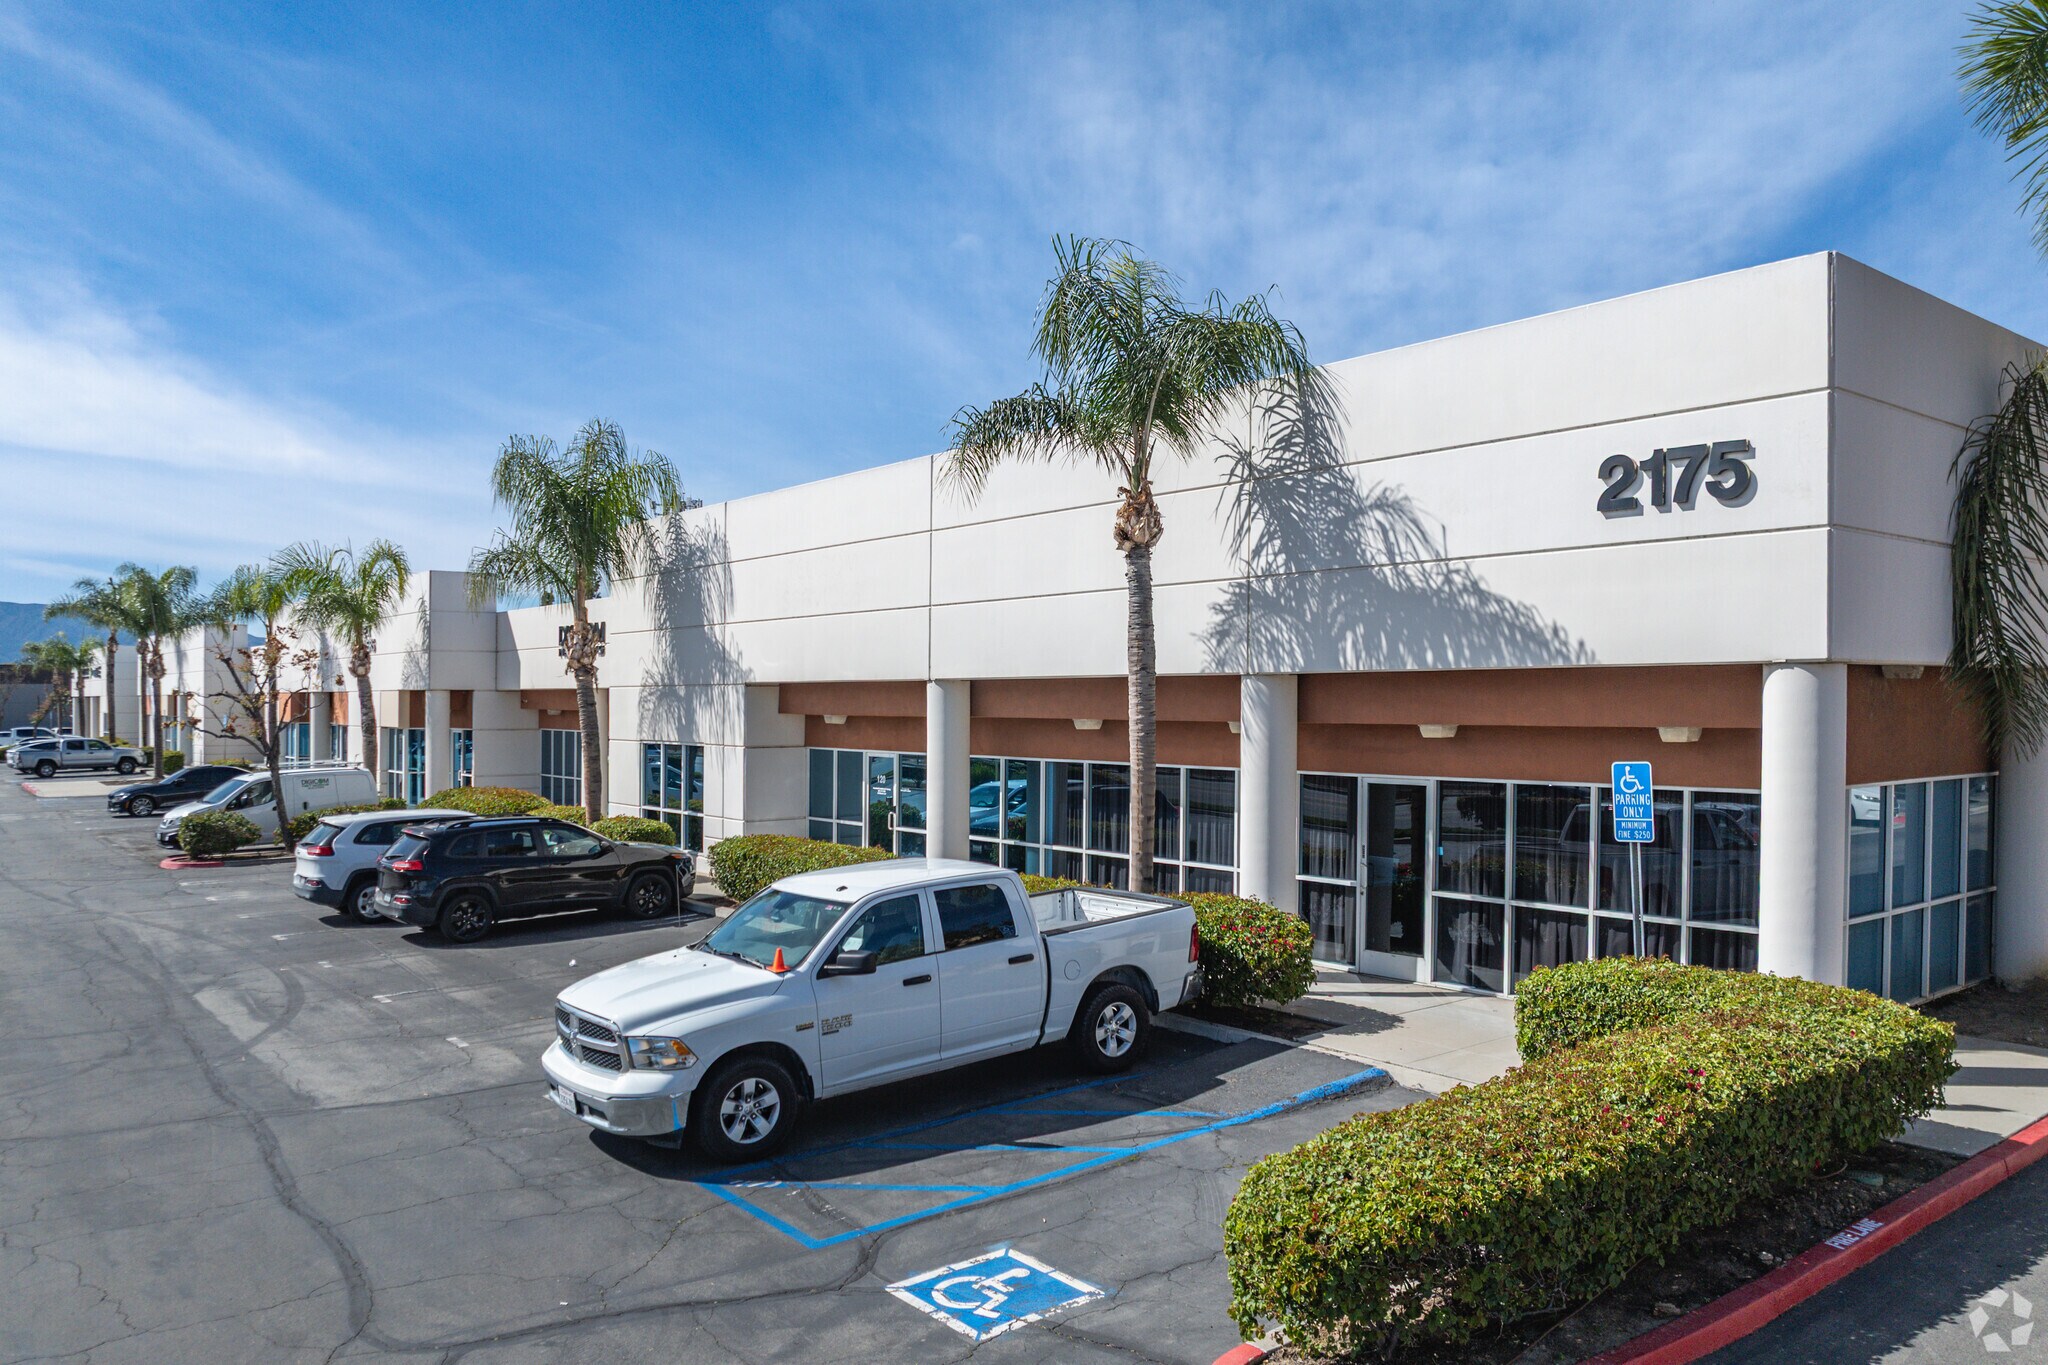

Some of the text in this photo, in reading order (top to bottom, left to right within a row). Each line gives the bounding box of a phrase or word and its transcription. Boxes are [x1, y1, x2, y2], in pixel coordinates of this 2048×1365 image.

[1597, 438, 1753, 512] 2175
[1615, 794, 1651, 805] PARKING
[1623, 806, 1644, 818] ONLY
[1621, 821, 1647, 830] MINIMUM
[1618, 830, 1651, 839] FINE $250
